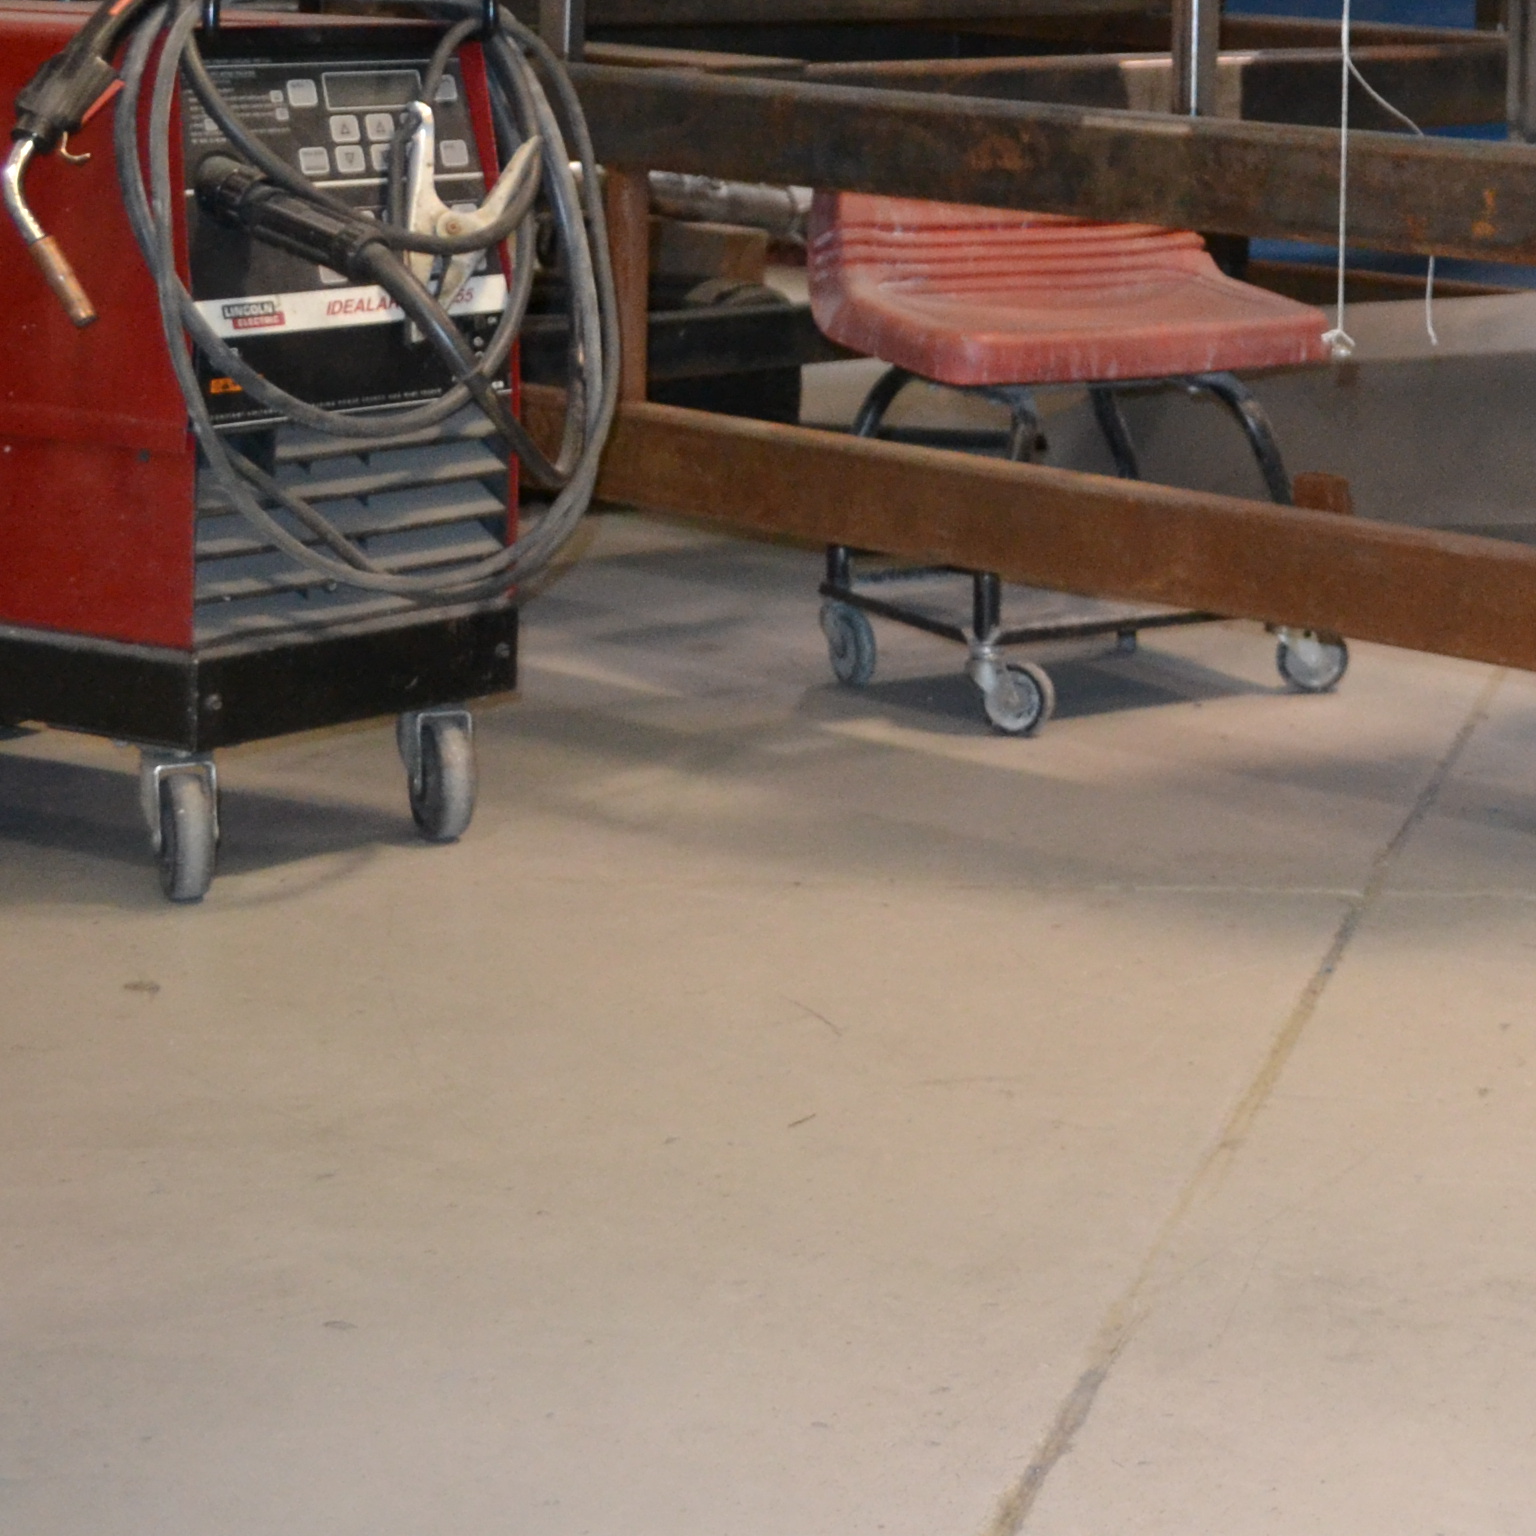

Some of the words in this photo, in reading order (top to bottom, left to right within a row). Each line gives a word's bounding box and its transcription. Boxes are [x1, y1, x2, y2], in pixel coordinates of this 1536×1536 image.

[224, 303, 273, 318] LINCOLN
[326, 295, 400, 315] IDEALAR
[237, 314, 280, 328] ELECTRIC
